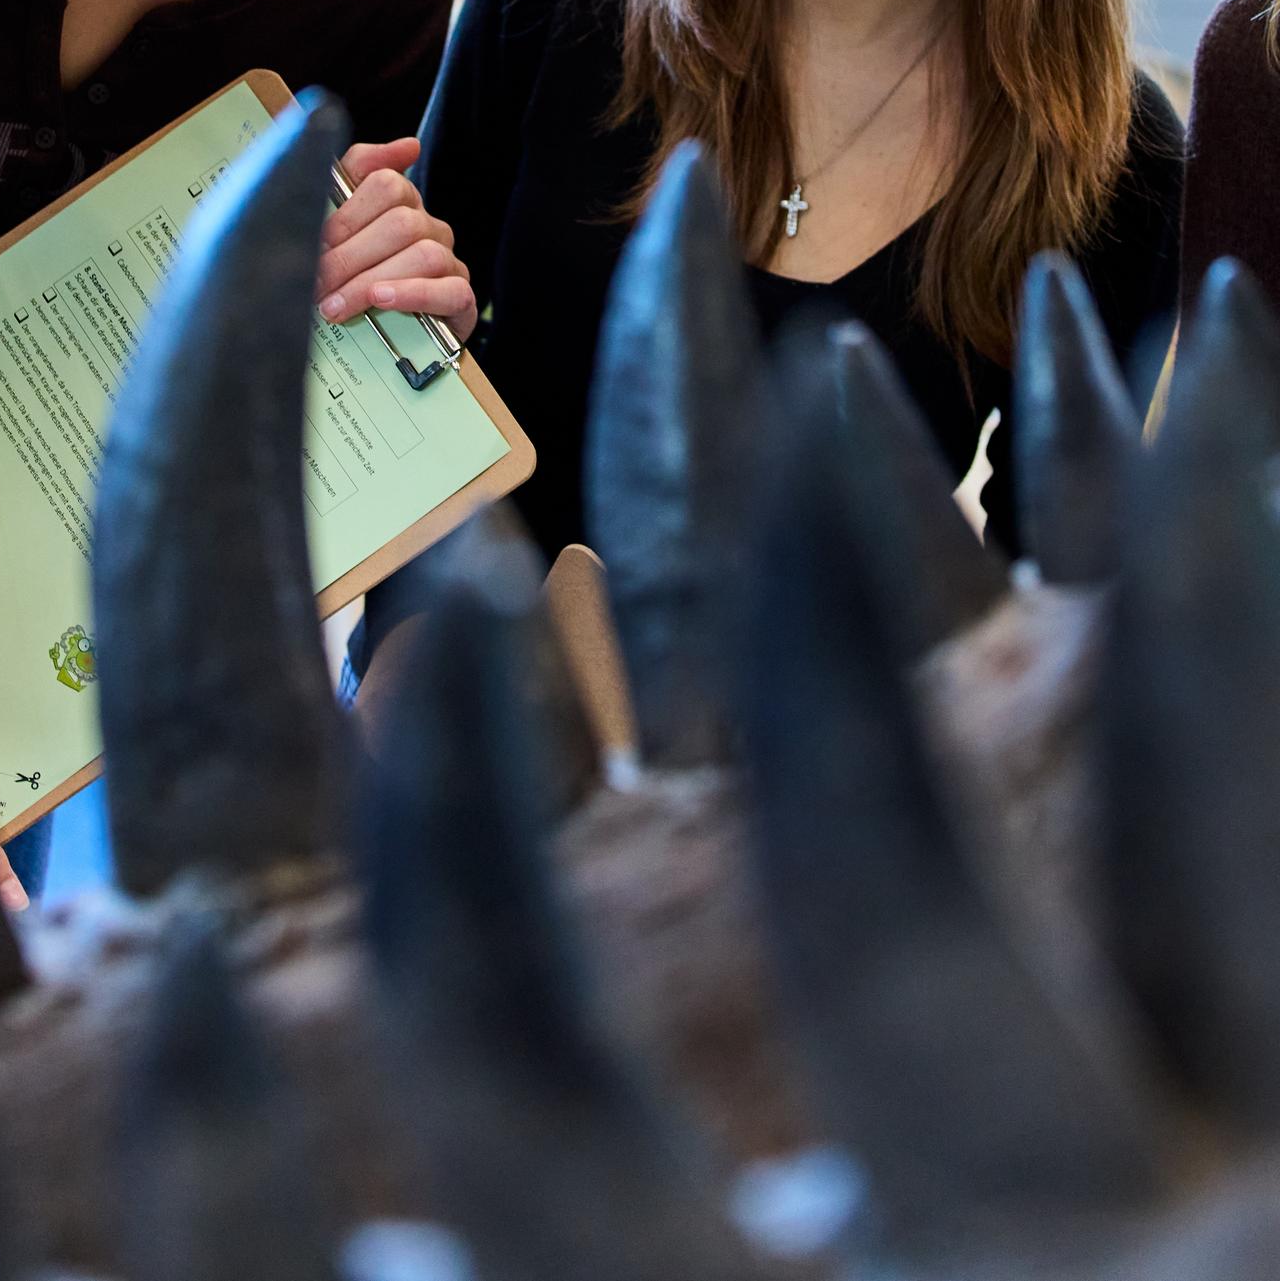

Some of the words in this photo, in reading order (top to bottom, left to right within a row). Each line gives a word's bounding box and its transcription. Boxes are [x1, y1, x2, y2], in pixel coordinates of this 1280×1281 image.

[135, 228, 148, 242] auf
[142, 239, 157, 256] dem
[153, 254, 169, 275] Stand
[150, 229, 162, 242] der
[154, 213, 163, 223] 7.
[29, 297, 37, 306] so
[34, 305, 51, 326] besser
[47, 324, 73, 360] verstecken.
[64, 279, 76, 292] auf
[72, 291, 86, 307] dem
[82, 306, 101, 330] Kasten
[74, 272, 93, 297] Schaue
[89, 296, 99, 307] dir
[96, 306, 109, 321] den
[104, 319, 132, 357] Triceratops
[83, 265, 93, 274] 8.
[89, 273, 106, 294] Stand
[101, 292, 121, 318] Saurier
[117, 316, 140, 346] Museum
[21, 323, 32, 336] Der
[57, 379, 66, 389] da
[62, 388, 74, 402] sich
[70, 401, 96, 437] Triceratops
[49, 303, 60, 316] Der
[56, 315, 84, 353] dunkelgrüne
[101, 383, 111, 393] Da
[317, 328, 328, 340] zur
[325, 339, 340, 357] Erde
[335, 354, 362, 389] gefallen?
[12, 334, 34, 363] Abdrücke
[50, 393, 61, 405] der
[56, 404, 85, 445] sogenannten
[19, 364, 30, 377] auf
[25, 375, 38, 390] den
[48, 411, 66, 434] Resten
[61, 431, 73, 445] der
[69, 443, 90, 472] Karotten
[336, 399, 352, 419] Beide
[348, 417, 374, 451] Meteorite
[17, 404, 28, 415] Da
[23, 413, 37, 429] kein
[32, 426, 52, 453] Mensch
[48, 451, 63, 470] diese
[58, 467, 86, 506] Dinosaurier
[21, 435, 54, 481] Überlegungen
[49, 479, 62, 493] und
[58, 492, 69, 505] mit
[65, 503, 81, 524] etwas
[307, 458, 337, 499] Maschinen
[336, 424, 348, 437] zur
[343, 434, 366, 464] gleichen
[362, 461, 376, 476] Zeit
[13, 442, 30, 464] Funde
[26, 463, 41, 481] weiss
[37, 480, 50, 496] man
[46, 495, 57, 507] nur
[53, 506, 67, 522] sehr
[62, 520, 79, 542] wenig
[75, 540, 84, 550] zu
